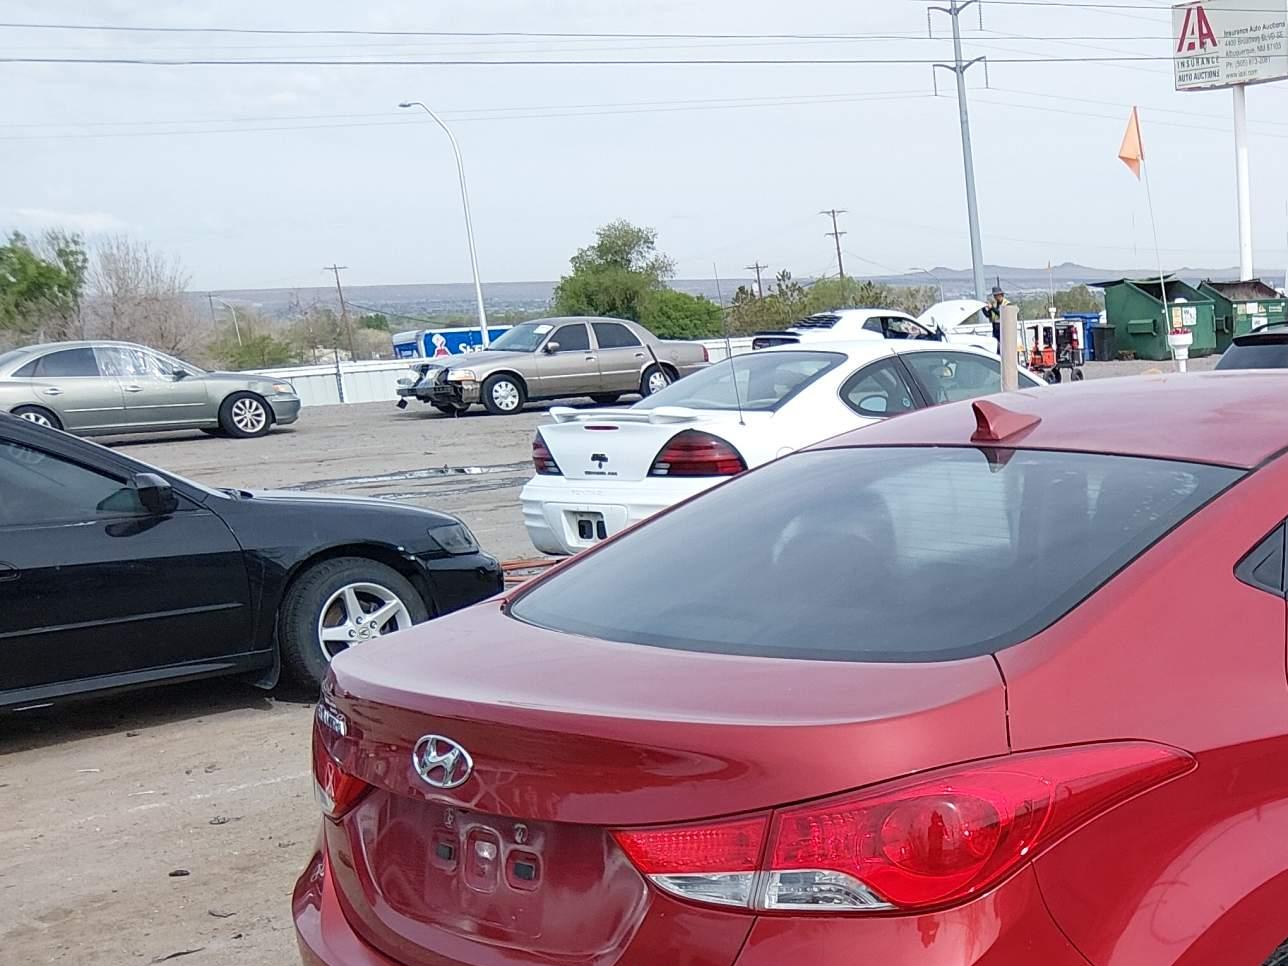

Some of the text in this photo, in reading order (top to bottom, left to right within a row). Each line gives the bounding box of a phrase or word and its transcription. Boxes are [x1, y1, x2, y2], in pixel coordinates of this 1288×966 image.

[1262, 21, 1285, 30] Auctions
[1177, 56, 1220, 69] INSURANCE
[1178, 69, 1220, 82] AUTO AUCTIONS
